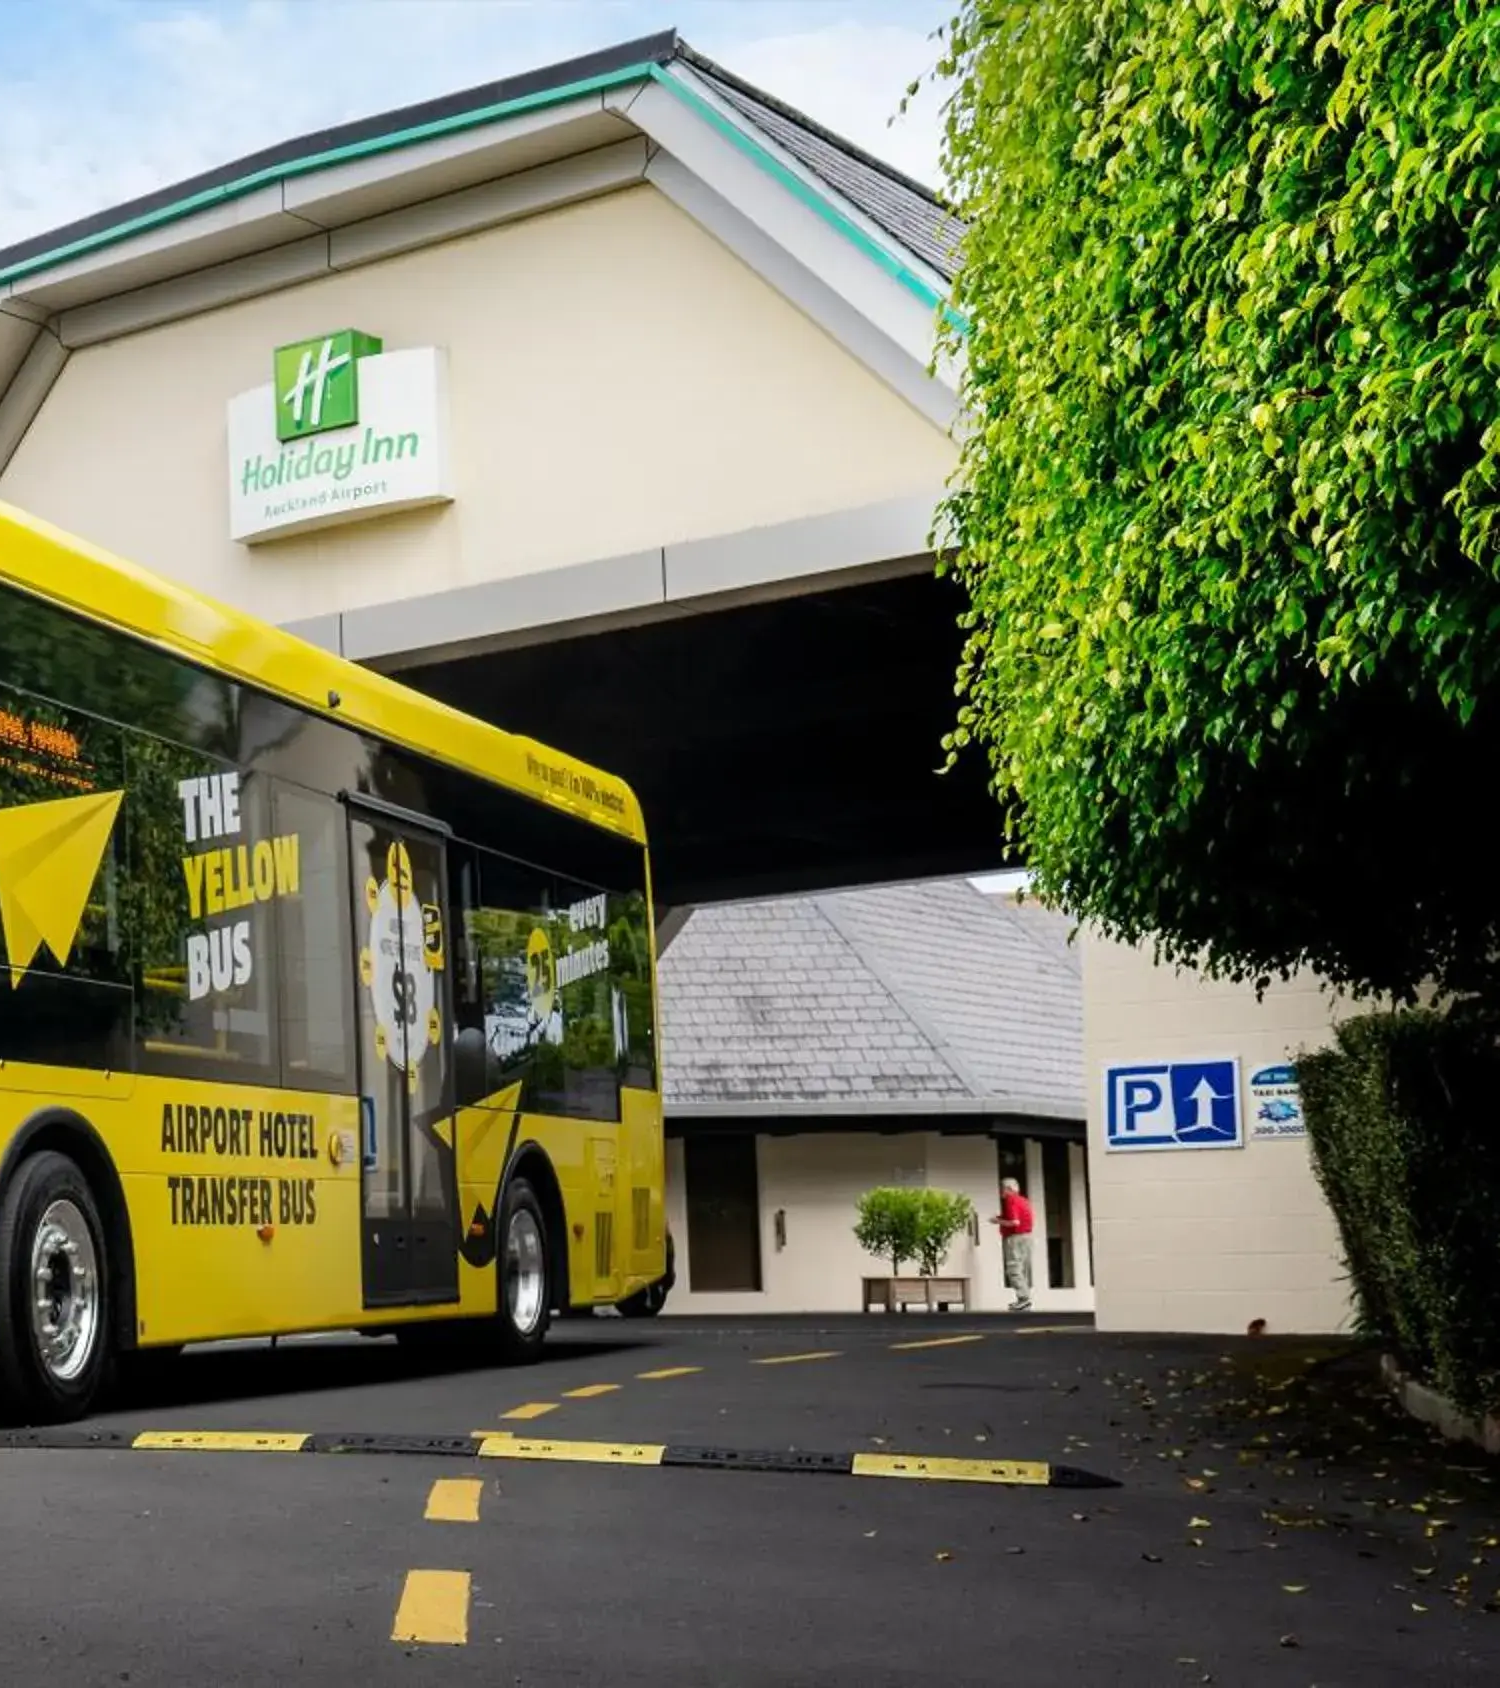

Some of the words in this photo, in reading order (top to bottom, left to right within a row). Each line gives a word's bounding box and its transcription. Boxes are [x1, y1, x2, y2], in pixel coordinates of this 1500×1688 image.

[241, 441, 355, 496] Holiday
[362, 428, 419, 464] Inn
[331, 480, 387, 501] Airport
[178, 772, 241, 842] THE
[182, 833, 299, 919] YELLOW
[569, 893, 606, 933] every
[187, 921, 252, 1001] BUS
[530, 948, 550, 998] 25
[556, 939, 609, 988] minutes
[161, 1103, 252, 1156] AIRPORT
[258, 1112, 318, 1159] HOTEL
[1124, 1080, 1162, 1131] P
[167, 1176, 273, 1225] TRANSFER
[279, 1179, 317, 1225] BUS
